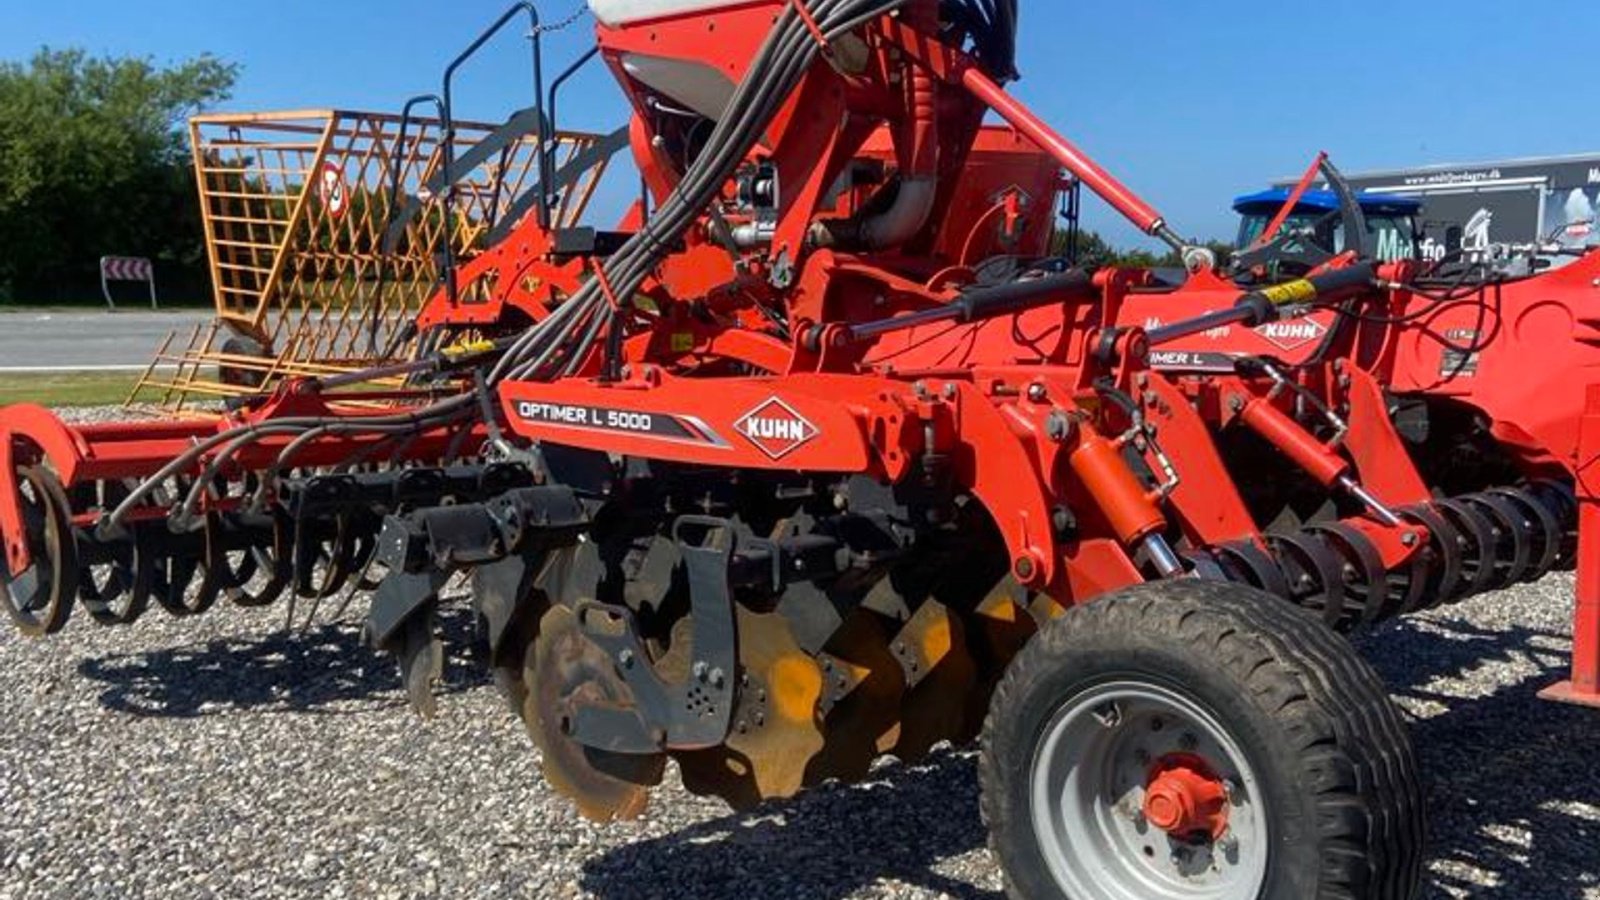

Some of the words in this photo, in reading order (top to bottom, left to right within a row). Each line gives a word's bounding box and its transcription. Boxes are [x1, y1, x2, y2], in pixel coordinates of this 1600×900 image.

[1264, 323, 1317, 338] KUHN
[1150, 351, 1189, 365] IMER
[1193, 353, 1204, 365] L
[519, 401, 587, 424] OPTIMER
[592, 409, 603, 425] L
[608, 410, 651, 430] 5000
[747, 417, 803, 440] KUHN
